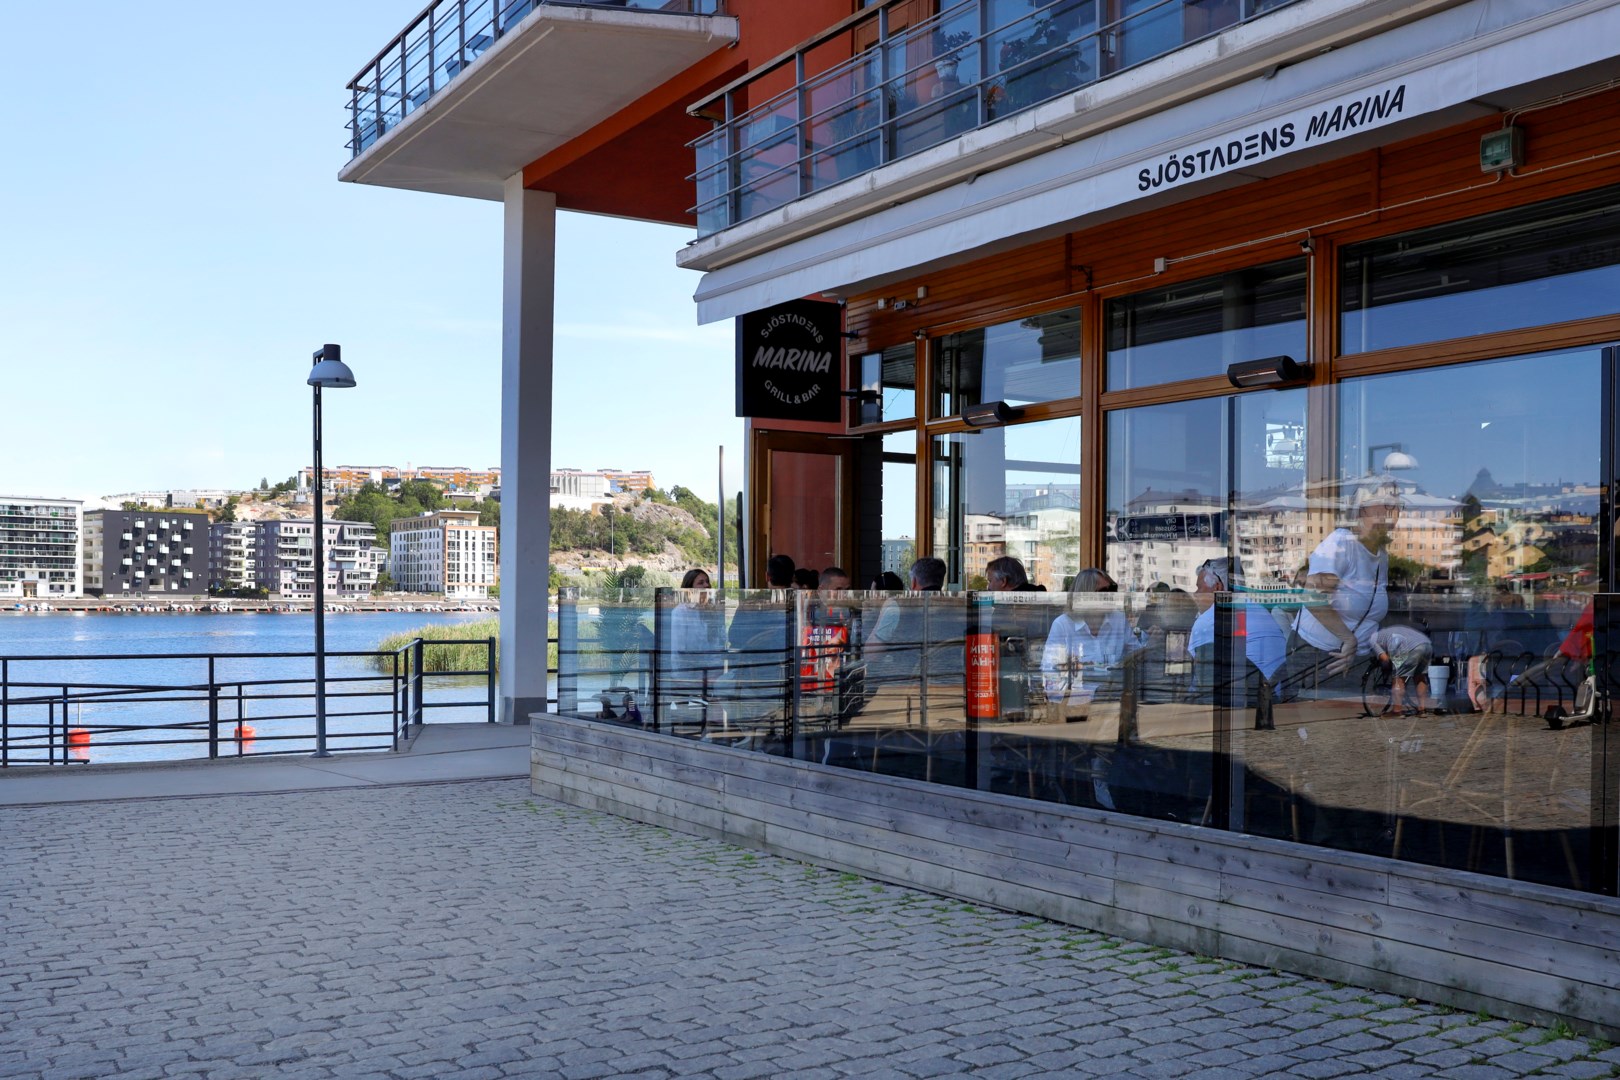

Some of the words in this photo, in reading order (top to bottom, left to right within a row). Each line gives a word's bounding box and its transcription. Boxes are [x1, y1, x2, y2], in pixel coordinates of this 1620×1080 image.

[1138, 123, 1296, 192] SJÖSTADENS
[1305, 85, 1406, 142] MARINA
[760, 313, 824, 344] SJÖSTADENS
[752, 345, 832, 374] MARINA
[764, 379, 792, 404] GRILL
[801, 383, 821, 402] BAR
